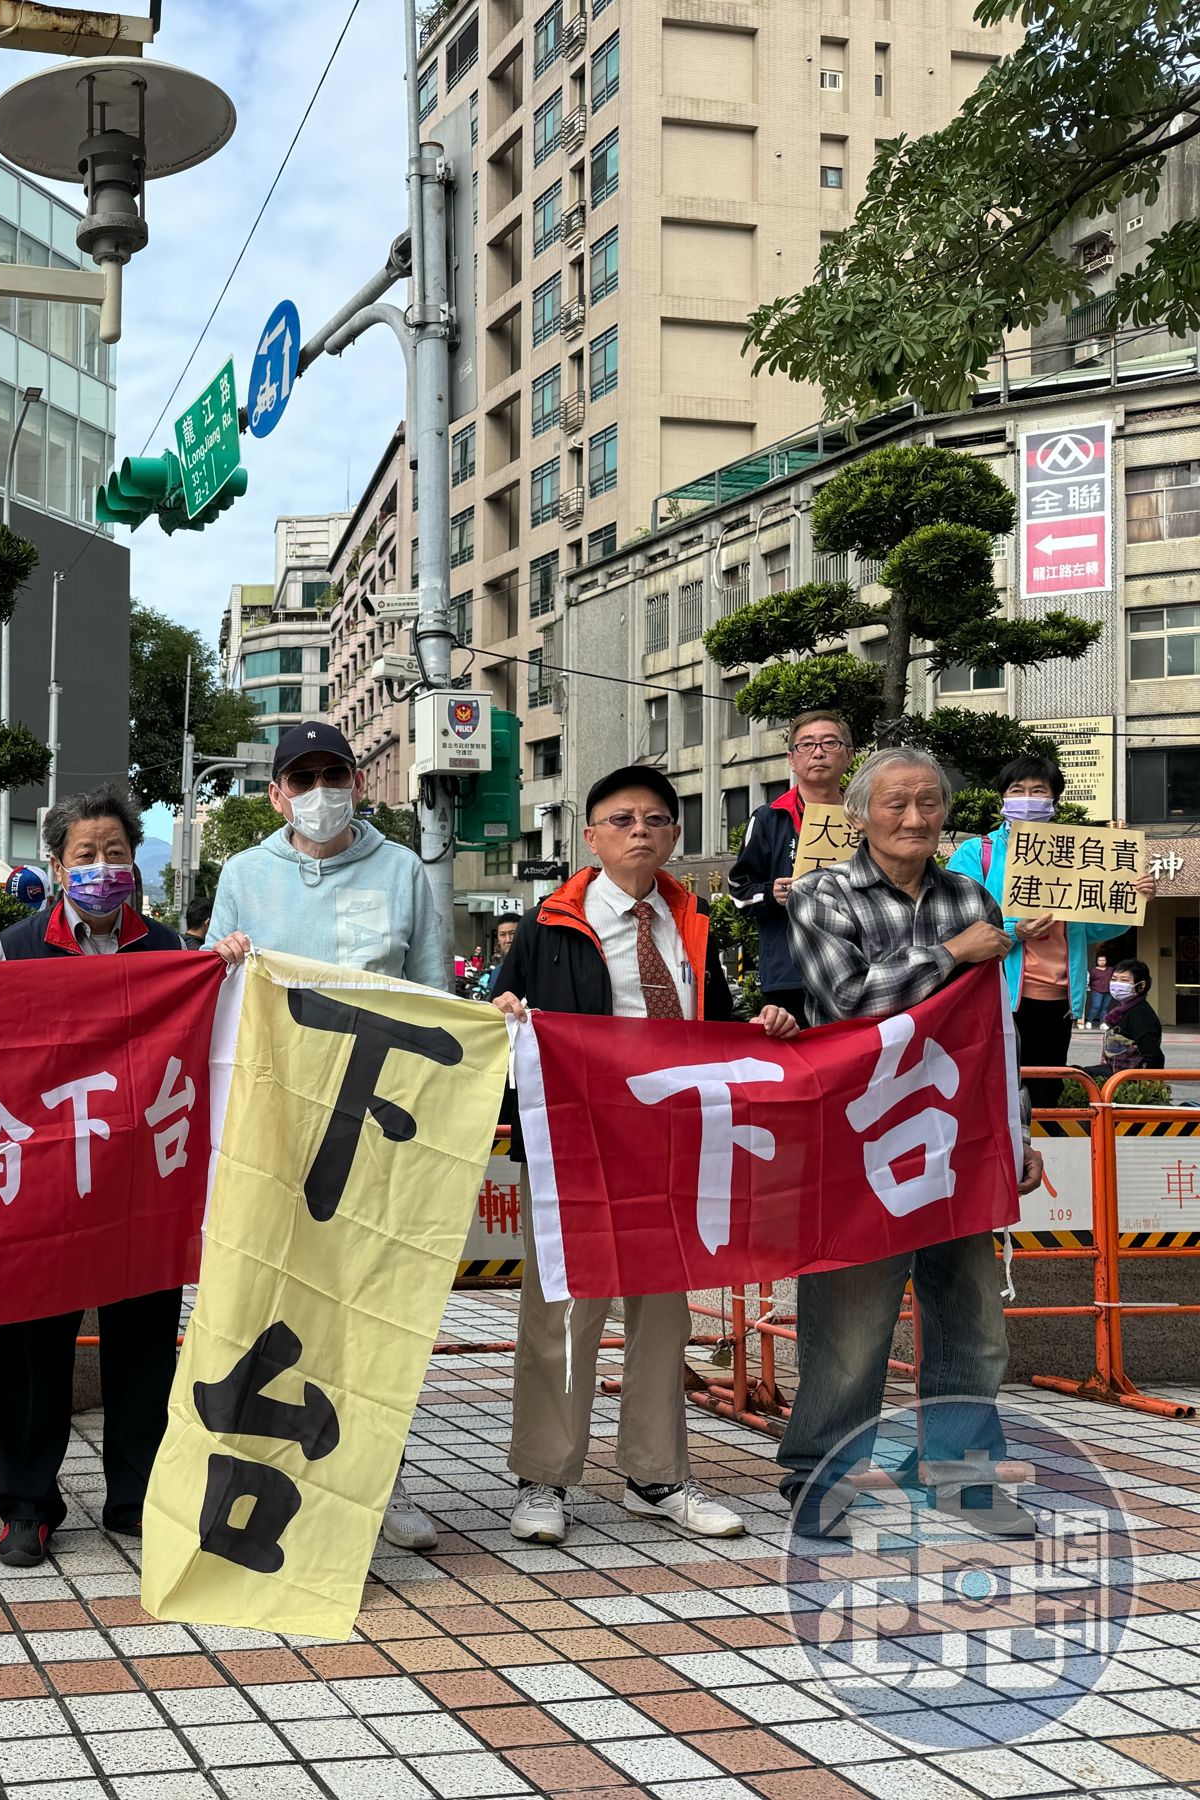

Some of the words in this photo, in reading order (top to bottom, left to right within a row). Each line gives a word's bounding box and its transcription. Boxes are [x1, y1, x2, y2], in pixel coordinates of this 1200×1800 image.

[182, 373, 231, 449] 龍江路
[187, 426, 221, 470] LongJiang
[222, 408, 233, 431] Rd.
[191, 463, 207, 487] 33-1
[194, 482, 210, 506] 22-2
[1031, 483, 1101, 515] 全聯
[1032, 561, 1099, 581] 龍江路左轉
[455, 724, 474, 733] POLICE
[1012, 831, 1139, 873] 敗選負責
[1149, 851, 1185, 881] 神
[500, 900, 521, 910] 占卜
[1007, 874, 1138, 915] 建立風範
[625, 1014, 960, 1256] 下台
[1161, 1159, 1200, 1210] 車
[1049, 1209, 1073, 1221] 109
[193, 988, 464, 1574] 下台
